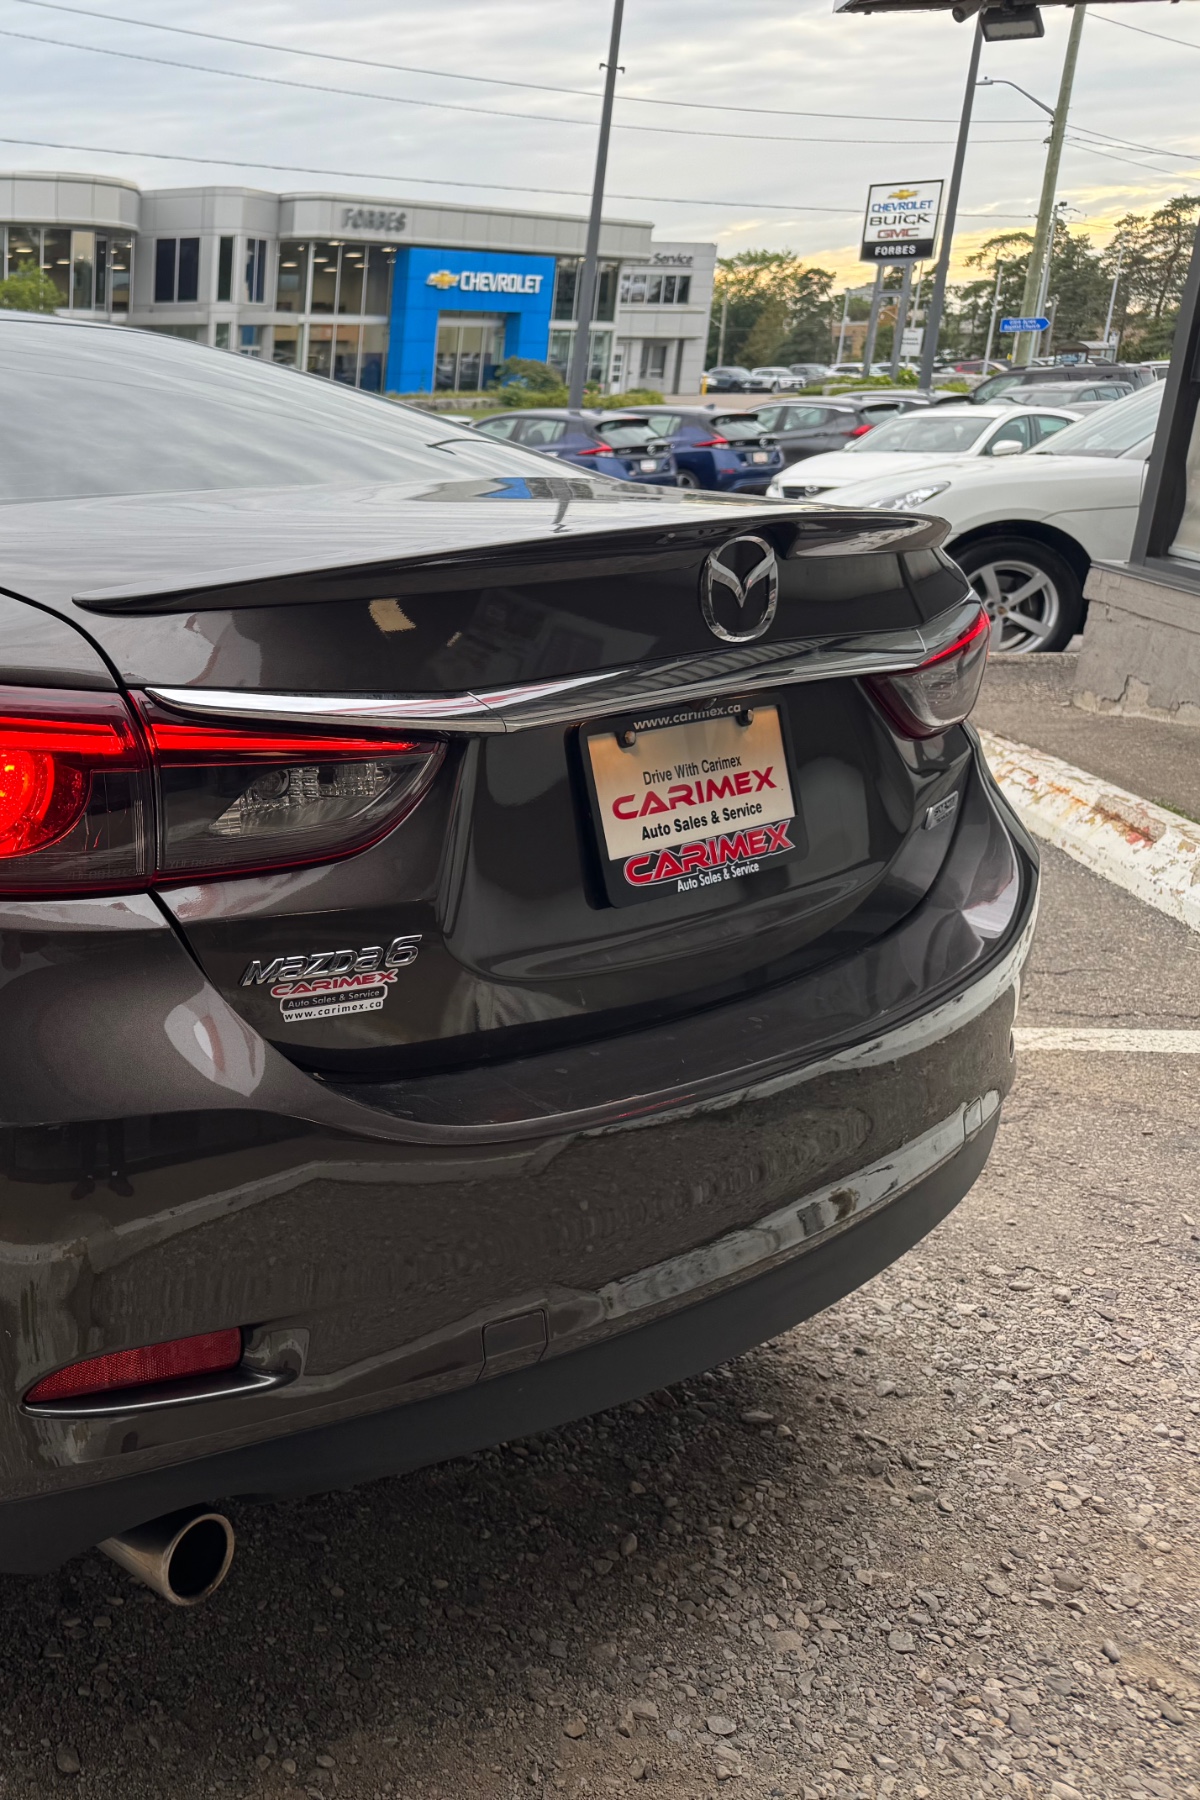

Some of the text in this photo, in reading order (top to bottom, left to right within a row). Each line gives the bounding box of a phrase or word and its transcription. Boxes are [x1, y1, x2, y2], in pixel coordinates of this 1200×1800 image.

[871, 199, 934, 213] CHEVROLET
[869, 212, 931, 227] BUICK
[877, 227, 920, 239] GMC
[654, 252, 693, 265] Service
[874, 244, 917, 257] FORBES
[460, 270, 544, 294] CHEVROLET
[643, 756, 743, 786] Drive With Carimex
[612, 766, 777, 820] CARIMEX
[641, 802, 763, 841] Auto Sales & Service
[624, 821, 794, 885] CARIMEX
[677, 861, 760, 893] Auto Sales & Service
[271, 970, 397, 996] CARIMEX
[284, 1000, 382, 1020] www.carimex.ca
[287, 989, 380, 1009] Auto Sales & Service
